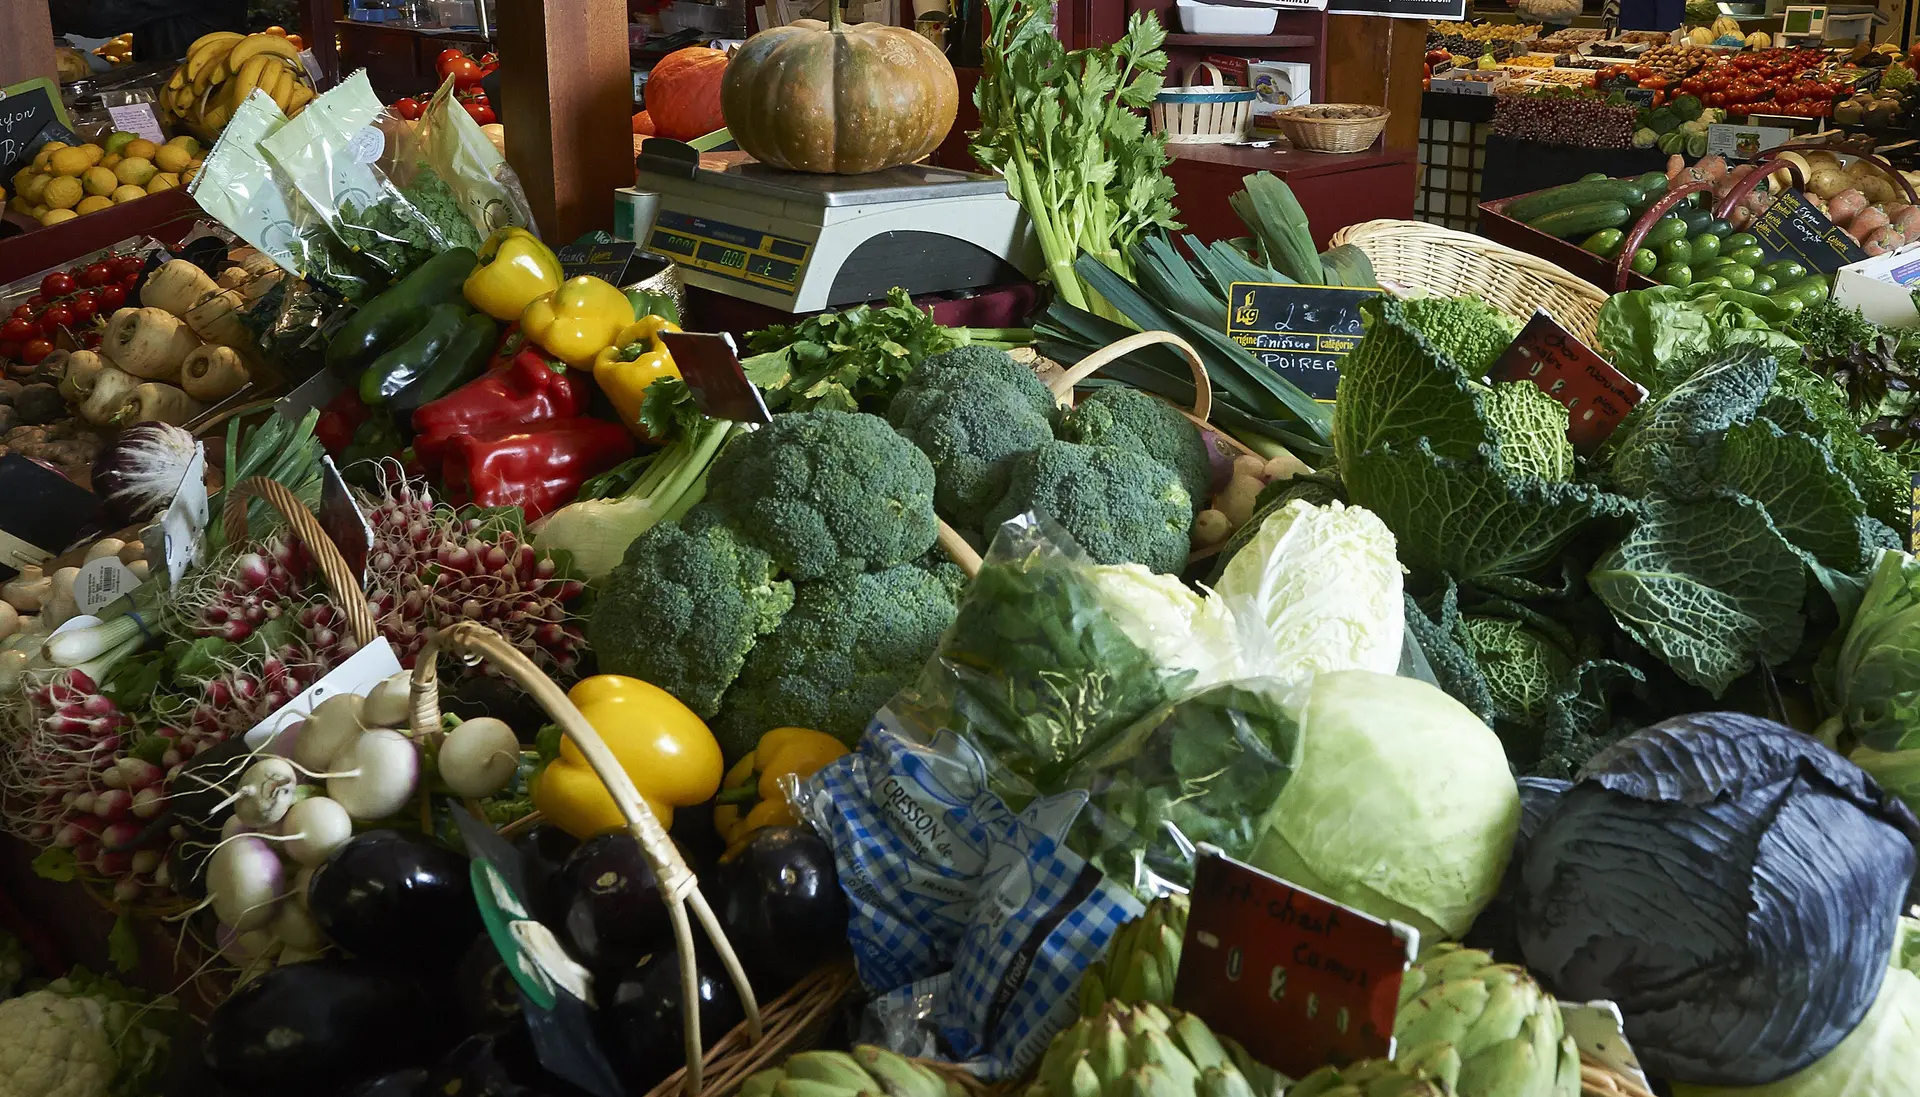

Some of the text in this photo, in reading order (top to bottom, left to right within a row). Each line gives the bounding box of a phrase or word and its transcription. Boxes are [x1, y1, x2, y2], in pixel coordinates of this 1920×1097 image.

[1235, 306, 1260, 326] kg
[1320, 338, 1355, 352] catégorie
[882, 778, 953, 857] CRESSON de
